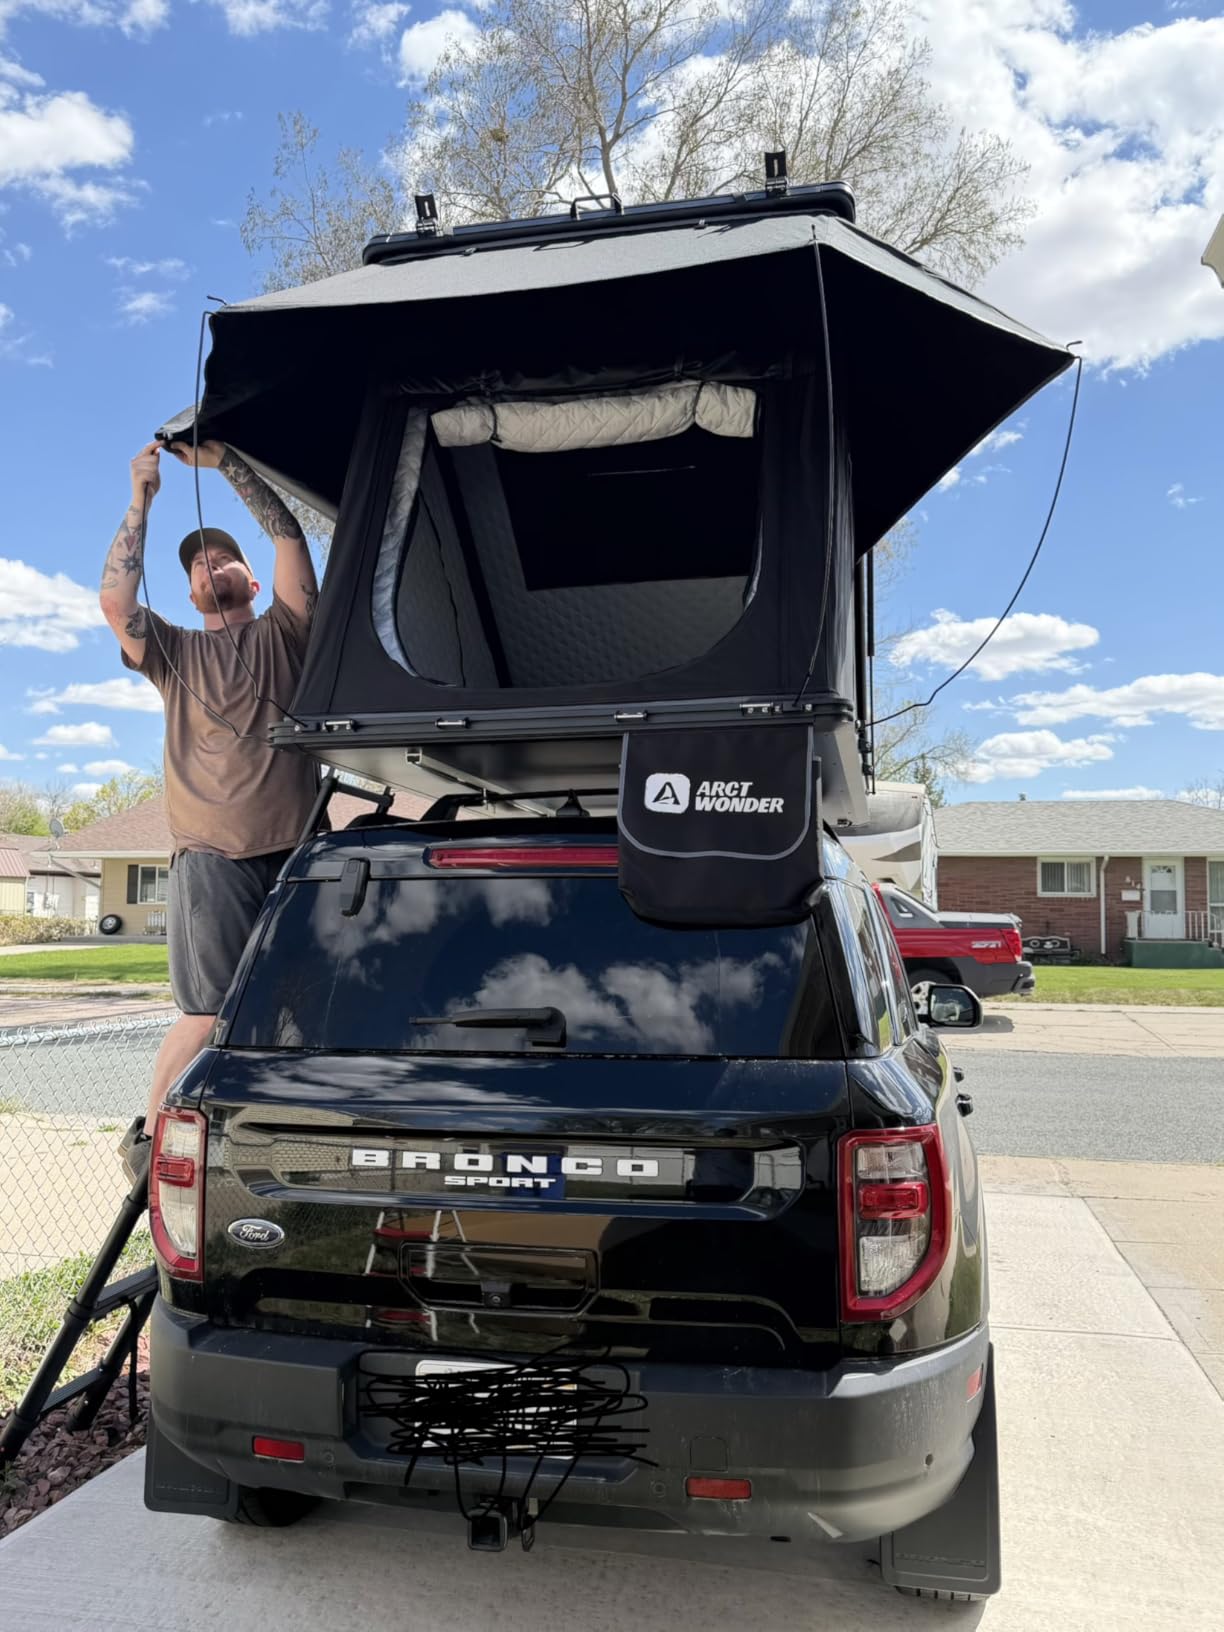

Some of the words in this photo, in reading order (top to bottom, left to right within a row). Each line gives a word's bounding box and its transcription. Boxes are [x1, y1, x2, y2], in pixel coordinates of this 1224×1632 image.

[696, 781, 753, 797] ARCT
[694, 797, 785, 813] WONDER
[352, 1149, 659, 1177] BRONCO
[444, 1176, 556, 1188] SPORT
[240, 1224, 270, 1241] Ford
